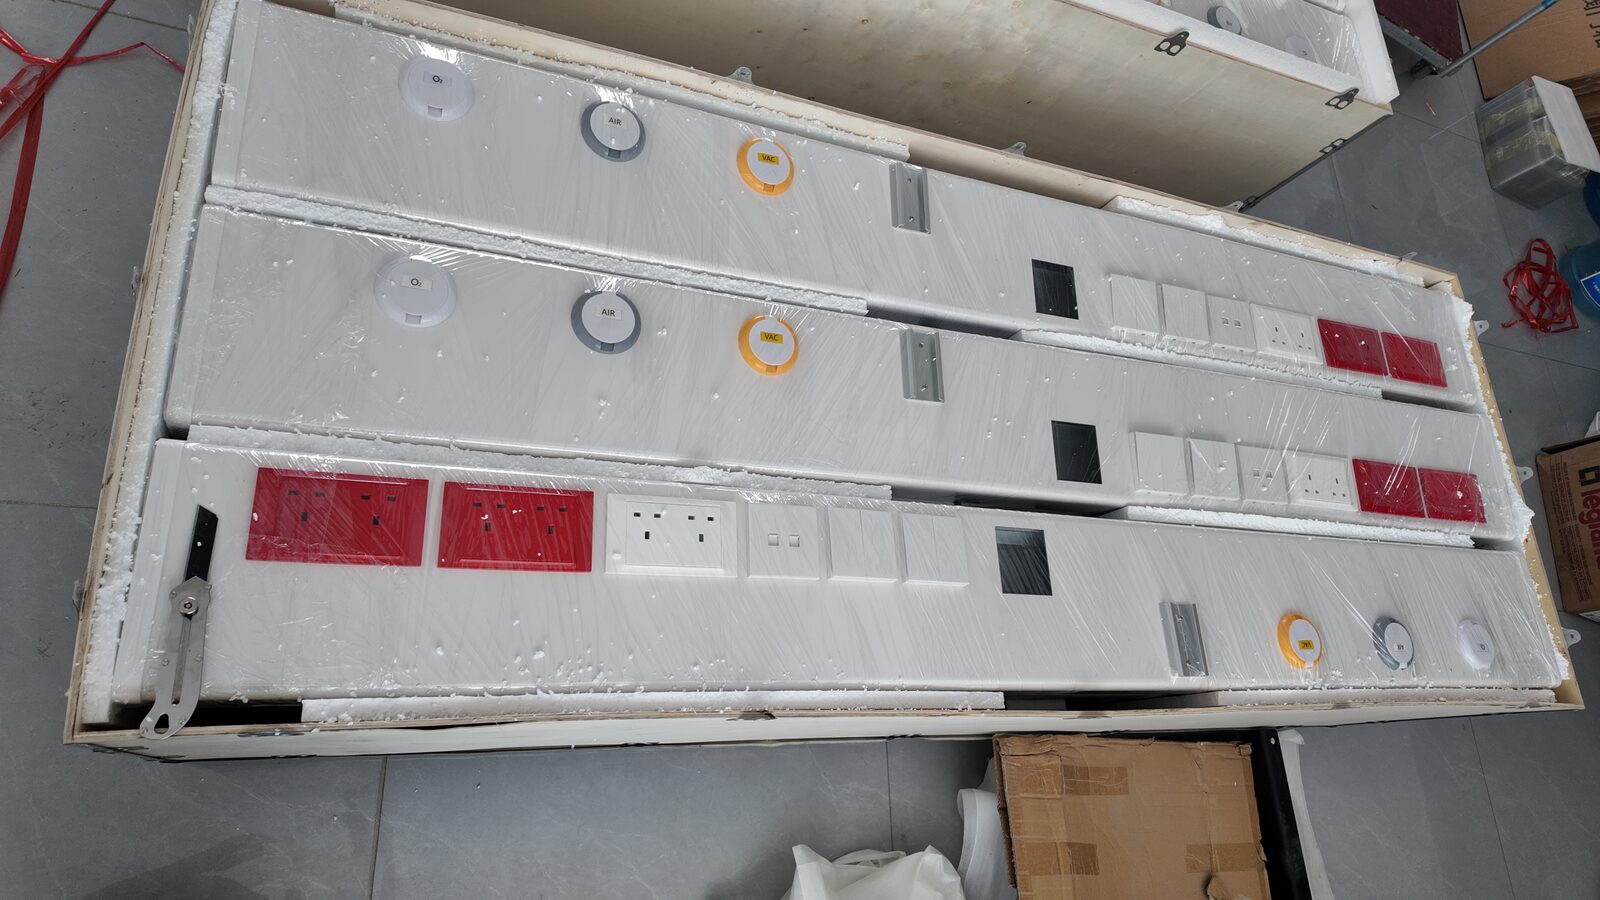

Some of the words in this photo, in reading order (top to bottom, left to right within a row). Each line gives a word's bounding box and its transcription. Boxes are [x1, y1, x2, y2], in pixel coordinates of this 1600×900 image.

[608, 117, 622, 126] AIR
[761, 154, 777, 164] VAC
[601, 308, 616, 317] AIR
[764, 332, 779, 342] VAC
